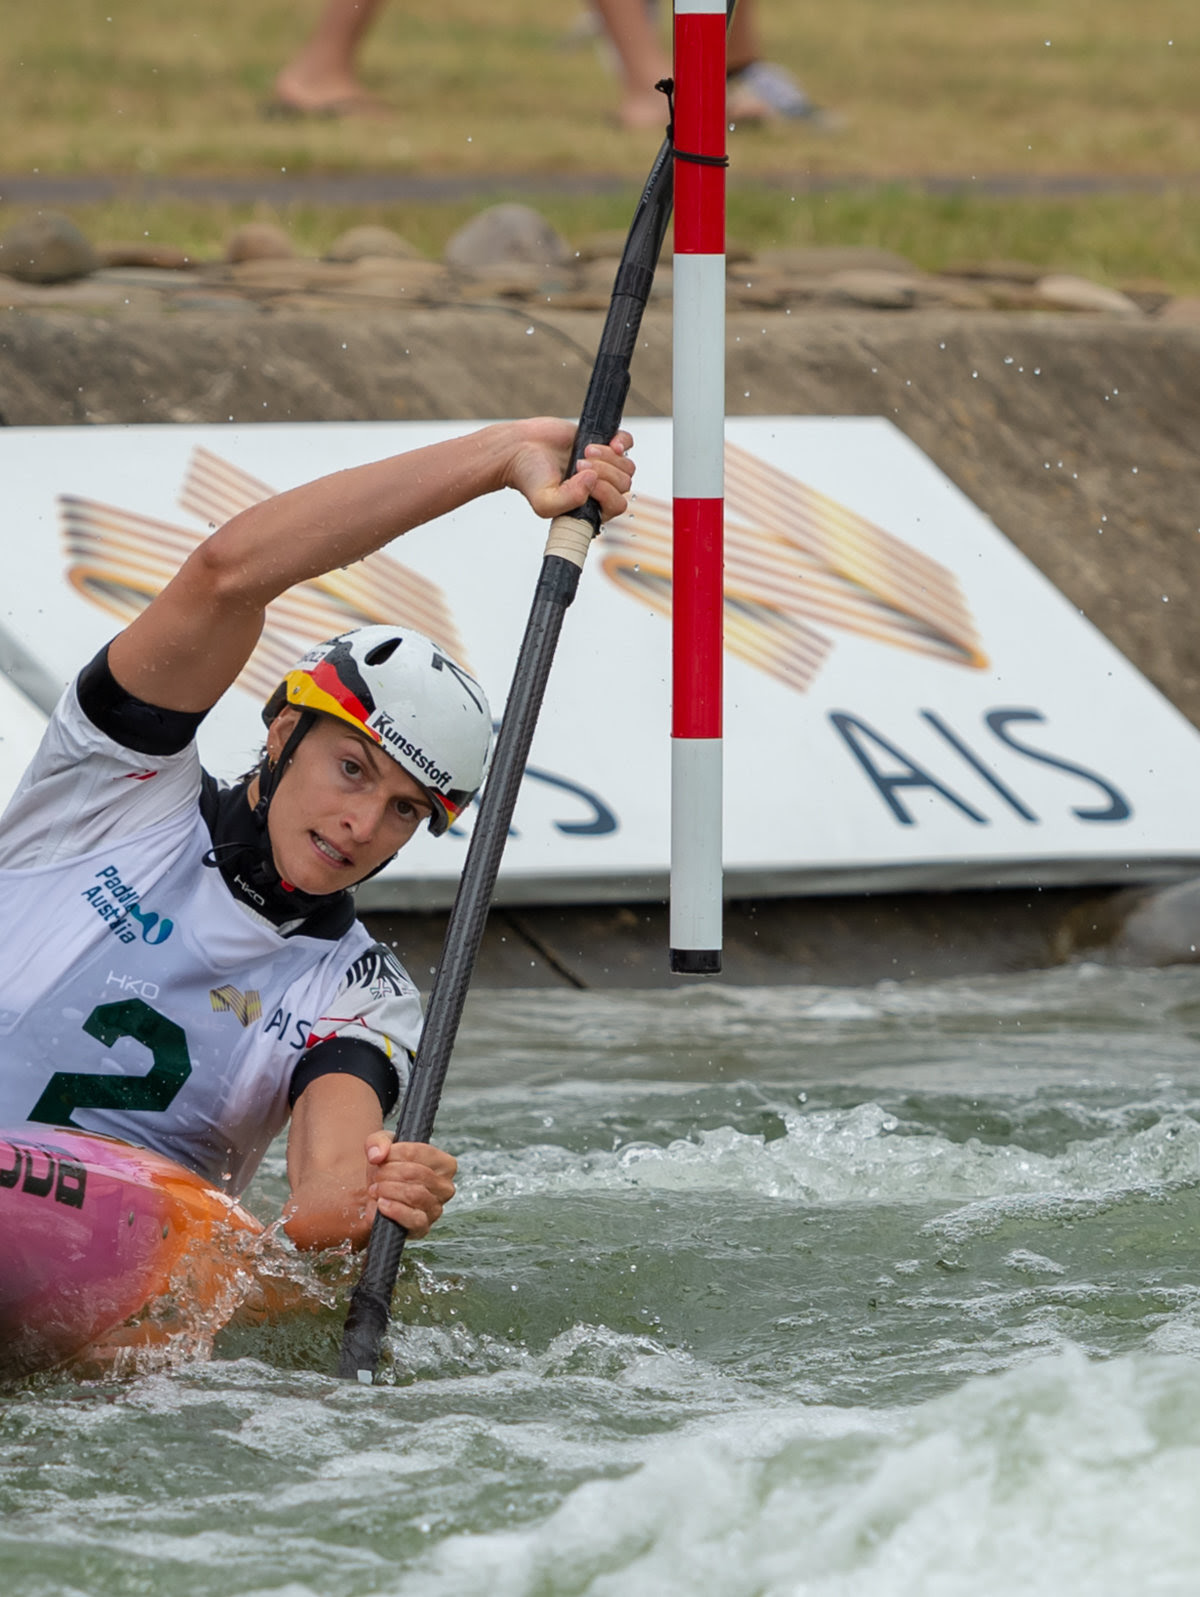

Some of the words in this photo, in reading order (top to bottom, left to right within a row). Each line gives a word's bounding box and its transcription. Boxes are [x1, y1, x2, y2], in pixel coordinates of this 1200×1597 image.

[372, 714, 453, 789] Kunststoff
[827, 706, 1134, 825] AIS
[26, 997, 192, 1131] 2
[264, 1007, 312, 1050] AIS
